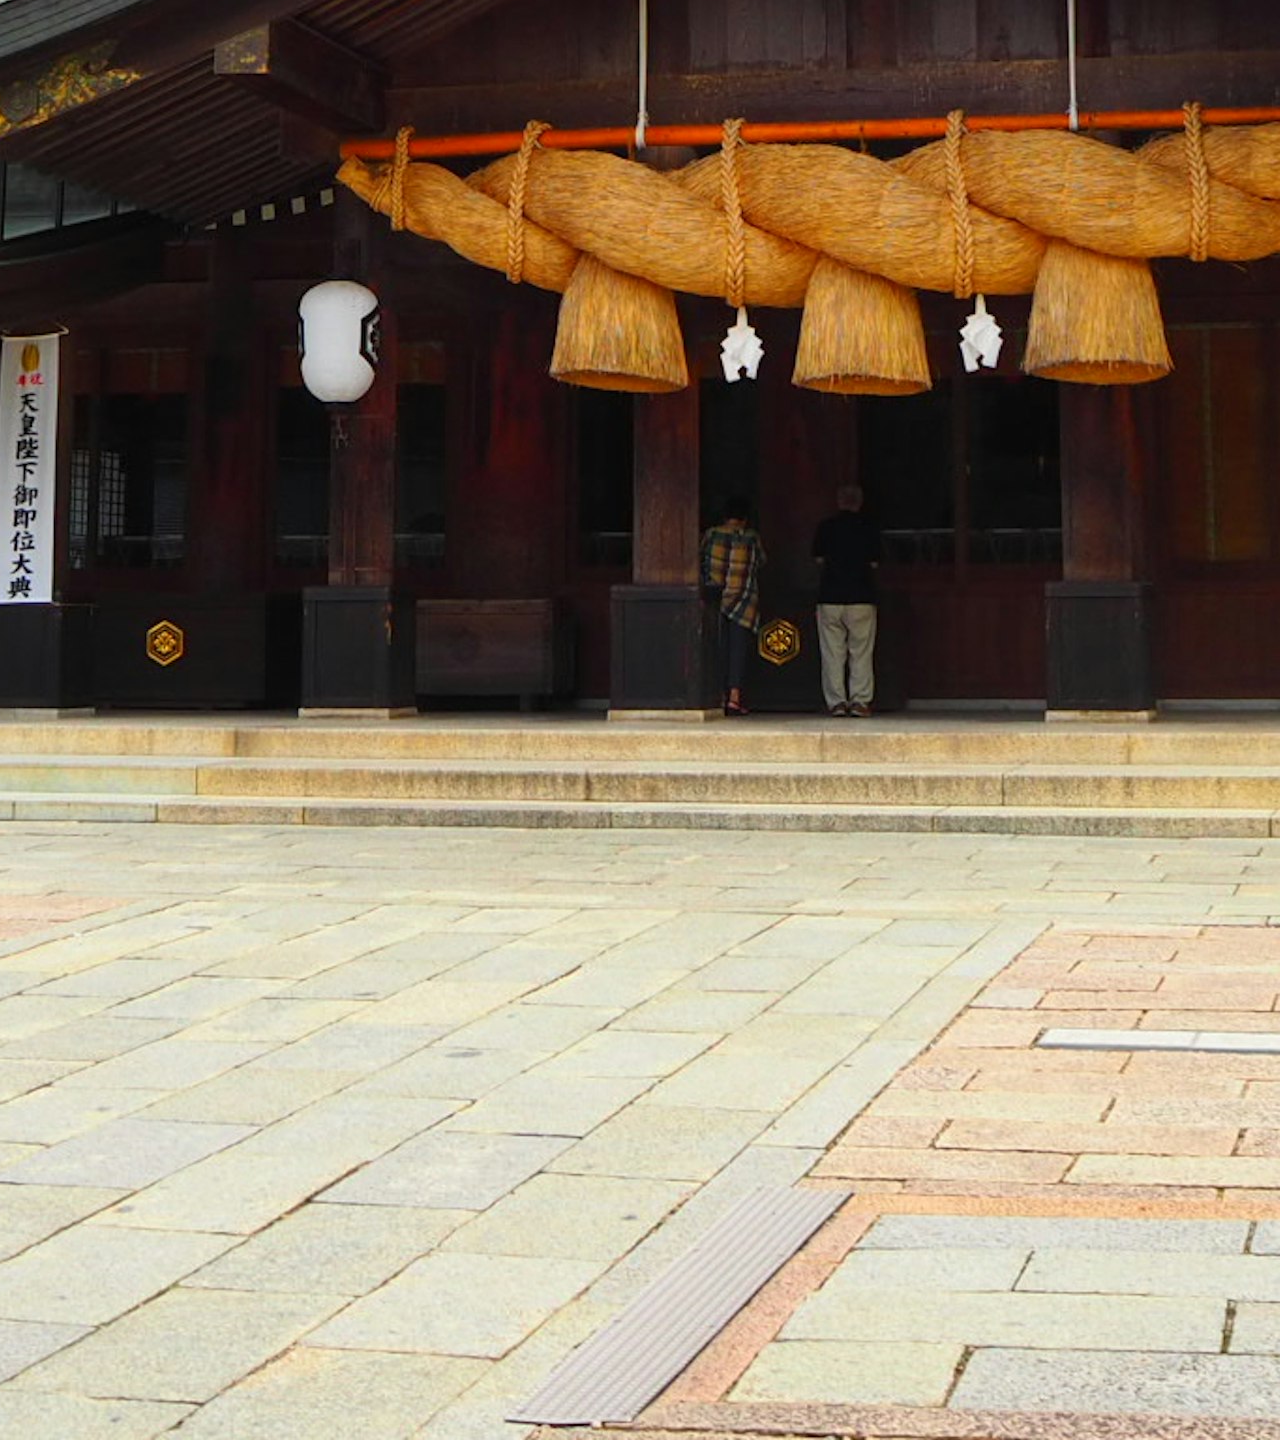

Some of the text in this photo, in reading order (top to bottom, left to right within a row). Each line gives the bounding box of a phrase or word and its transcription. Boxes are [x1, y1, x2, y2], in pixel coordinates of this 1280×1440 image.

[7, 392, 40, 600] 天皇陛下御即位大典
